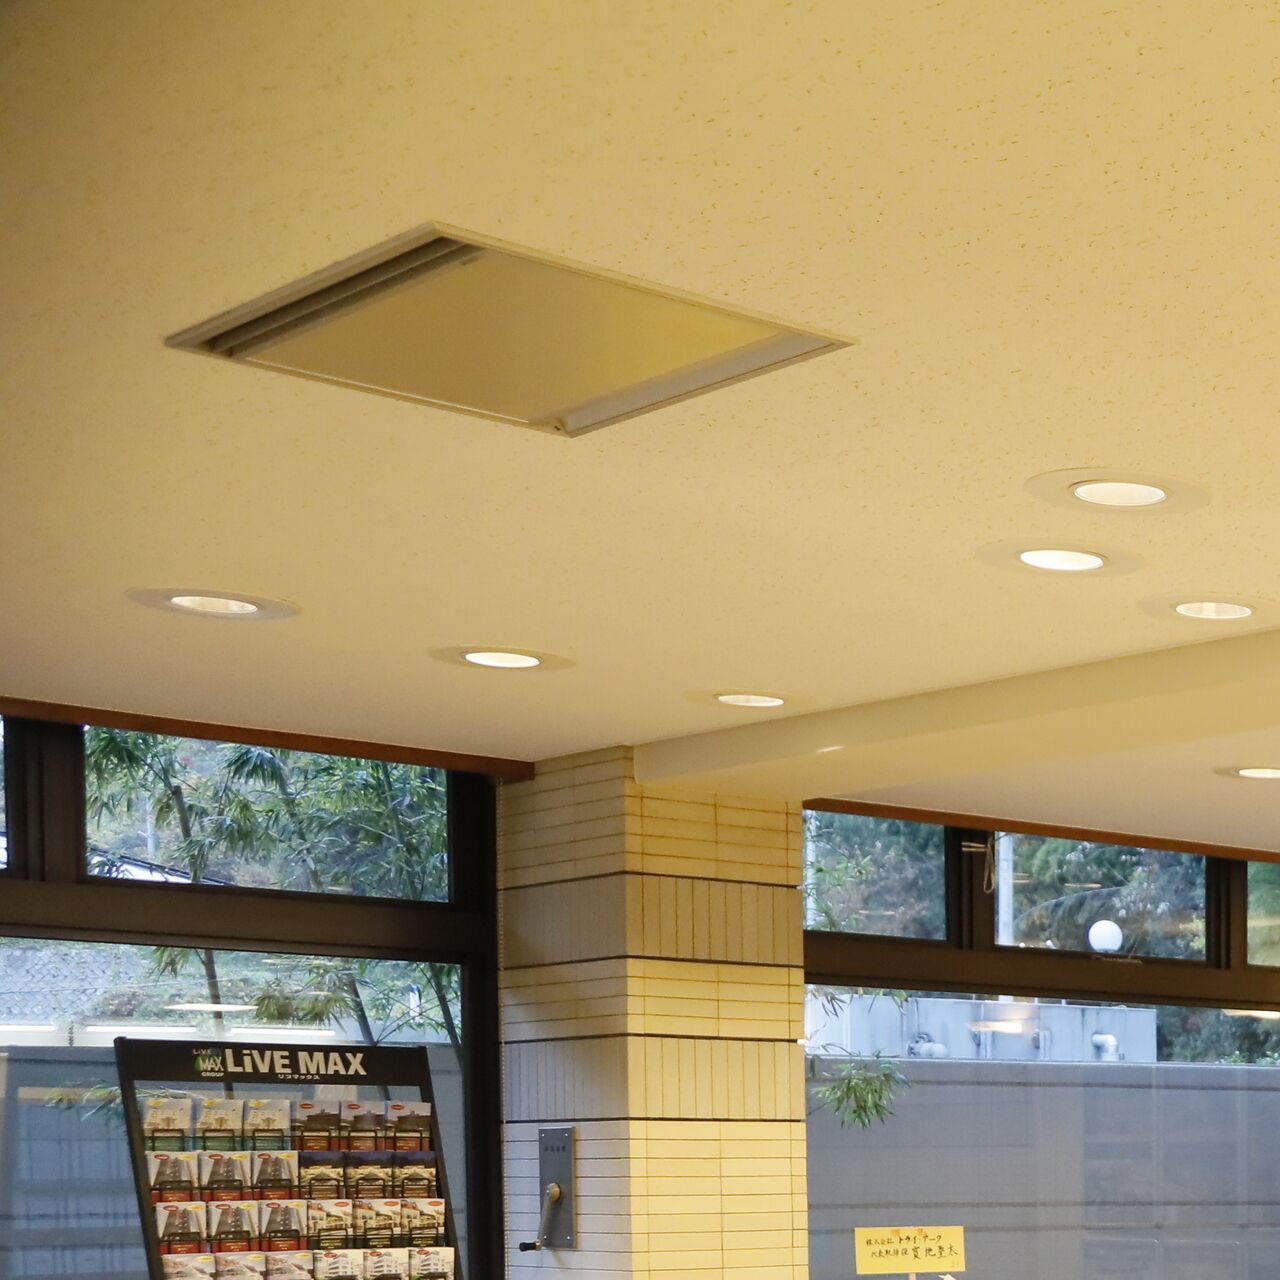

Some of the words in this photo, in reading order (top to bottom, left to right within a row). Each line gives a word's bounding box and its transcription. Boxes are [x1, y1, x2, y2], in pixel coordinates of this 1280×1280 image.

[200, 1056, 224, 1072] MAX
[225, 1048, 292, 1074] LiVE
[298, 1051, 367, 1076] MAX
